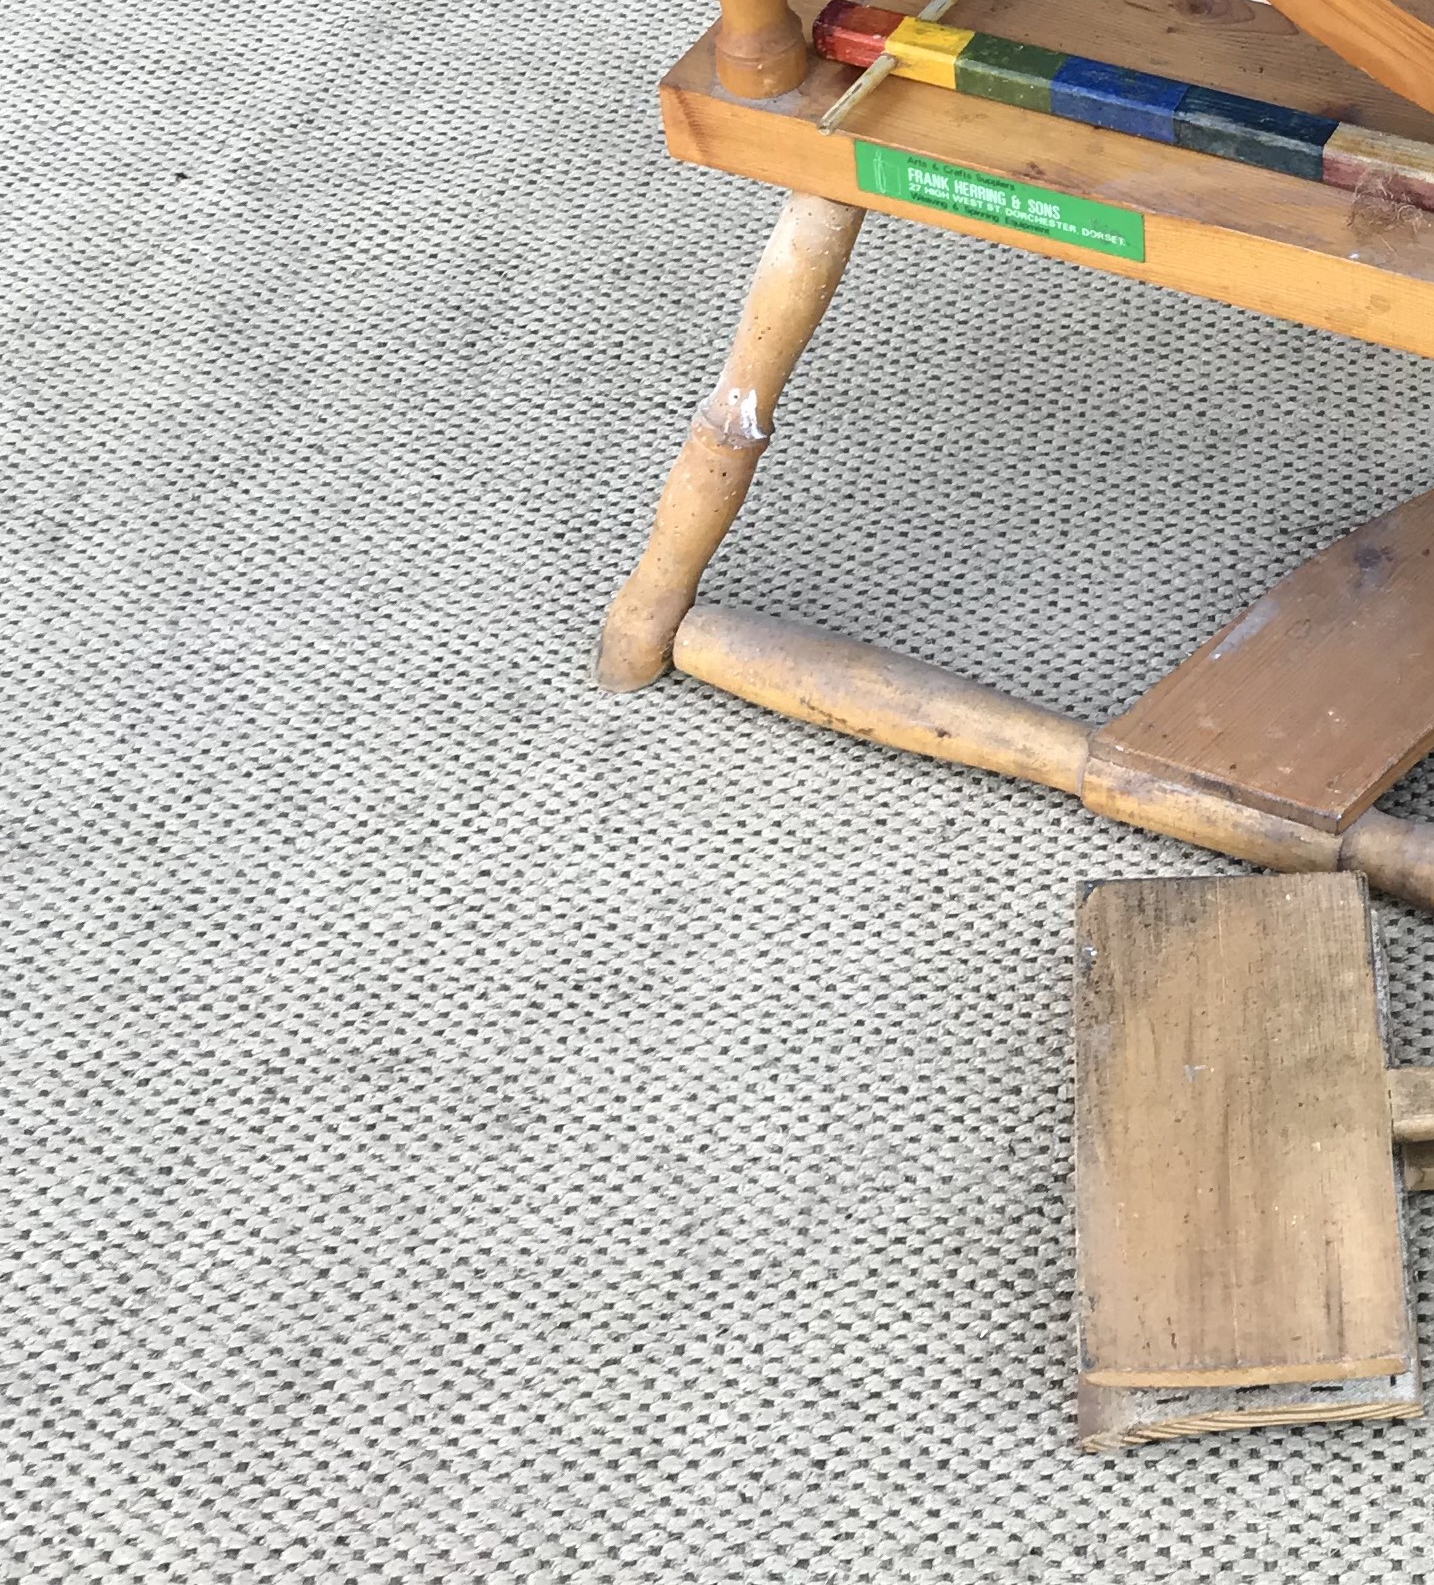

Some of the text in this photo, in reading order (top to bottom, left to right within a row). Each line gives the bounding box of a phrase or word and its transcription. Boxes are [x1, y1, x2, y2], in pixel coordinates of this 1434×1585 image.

[907, 167, 1061, 220] FRANK HERRING & SONS
[924, 186, 950, 200] HIGH
[952, 194, 984, 209] WEST
[986, 203, 1000, 213] ST
